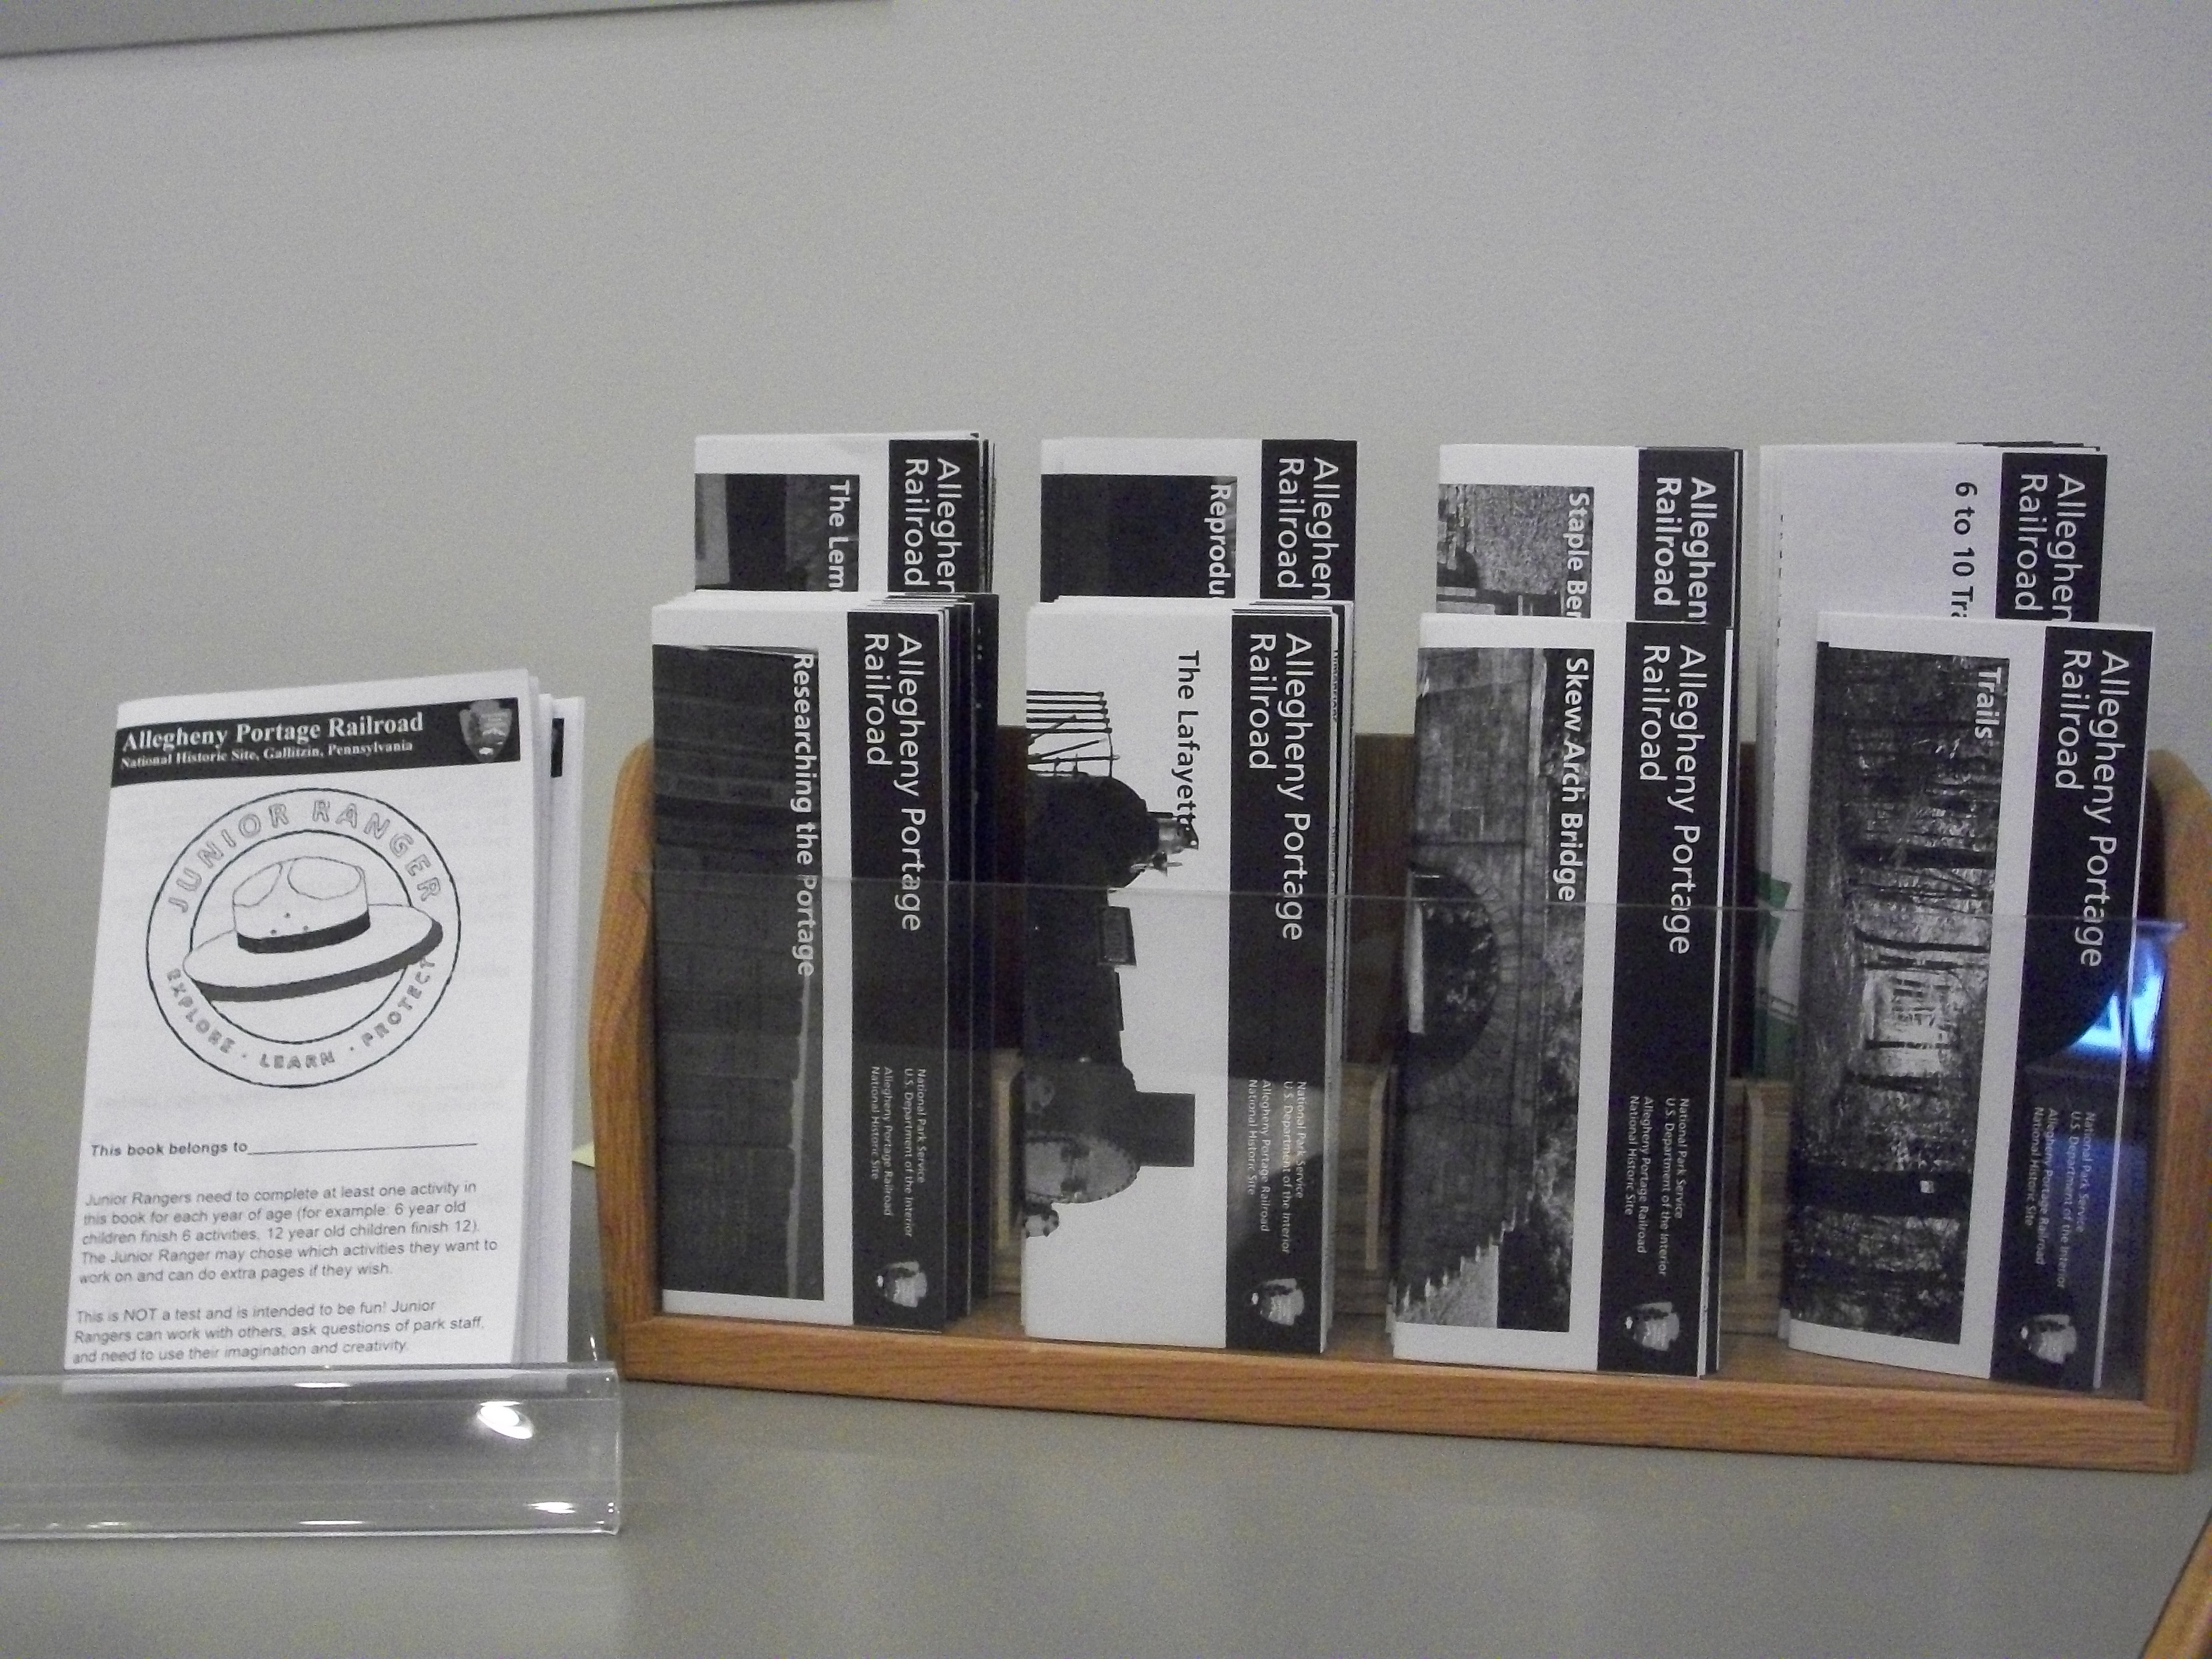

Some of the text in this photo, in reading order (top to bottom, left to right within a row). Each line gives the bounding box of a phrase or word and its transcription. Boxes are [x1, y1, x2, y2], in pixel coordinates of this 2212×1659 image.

[828, 479, 851, 527] The
[904, 459, 930, 585] Railroad
[1203, 484, 1233, 597] Reprodu
[1277, 458, 1305, 588] Railroad
[1564, 492, 1590, 571] Staple
[1654, 478, 1682, 606] Railroad
[1681, 477, 1717, 620] Alleghen
[1953, 482, 1978, 577] 6 to 10
[2015, 474, 2048, 610] Railroad
[123, 712, 423, 751] Allegheny Portage Railroad
[865, 634, 892, 765] Railroad
[1177, 650, 1200, 700] The
[1249, 634, 1276, 769] Railroad
[1640, 645, 1670, 780] Railroad
[1975, 667, 2002, 739] Trails
[2056, 650, 2091, 789] Railroad
[121, 754, 173, 768] National
[176, 751, 227, 764] Historic
[231, 750, 259, 761] Site,
[328, 740, 413, 756] Pennsylvania
[892, 634, 926, 931] Allegheny Portage
[1275, 633, 1313, 940] Allegheny Portage
[1553, 658, 1589, 901] Skew Arch Bridge
[1663, 645, 1707, 954] Allegheny Portage
[2075, 650, 2130, 967] Allegheny Portage
[169, 799, 441, 913] JUNIOR RANGER
[790, 654, 818, 977] Researching the Portage
[166, 957, 436, 1070] EXPLORE LEARN PROTECT
[85, 1182, 477, 1208] Junior Rangers need to complete at least one activity in
[91, 1141, 248, 1157] This book belongs to
[1624, 1095, 1640, 1215] National Historic Site
[1636, 1096, 1653, 1254] Allegheny Portage Railroad
[1661, 1195, 1672, 1208] of
[1662, 1123, 1675, 1192] Department
[1674, 1098, 1690, 1219] National Park Service
[82, 1232, 136, 1245] children
[140, 1230, 178, 1243] finish
[182, 1229, 191, 1242] 6
[268, 1227, 284, 1240] 12
[288, 1228, 320, 1242] year
[324, 1225, 345, 1238] old
[349, 1223, 406, 1237] children
[410, 1221, 449, 1234] finish
[82, 1239, 498, 1265] The Junior Ranger may chose which activities they want to
[84, 1214, 107, 1225] this
[111, 1212, 145, 1225] book
[150, 1211, 169, 1224] for
[173, 1211, 208, 1223] each
[212, 1211, 243, 1224] year
[248, 1207, 262, 1221] of
[265, 1209, 293, 1224] age
[394, 1202, 404, 1215] 6
[409, 1204, 441, 1218] year
[444, 1200, 466, 1213] old
[1658, 1233, 1670, 1276] Interior
[1660, 1211, 1671, 1230] the
[77, 1301, 436, 1323] This is NOT a test and is intended to be fun! Junior
[79, 1271, 110, 1285] work
[114, 1272, 133, 1283] on
[137, 1270, 164, 1283] and
[168, 1271, 194, 1282] can
[198, 1268, 216, 1281] do
[220, 1268, 257, 1280] extra
[260, 1267, 305, 1282] pages
[309, 1264, 319, 1277] if
[322, 1265, 352, 1279] they
[72, 1350, 97, 1364] and
[101, 1349, 137, 1363] need
[140, 1349, 154, 1361] to
[158, 1349, 185, 1361] use
[189, 1347, 220, 1360] their
[225, 1345, 306, 1360] imagination
[310, 1342, 338, 1354] and
[74, 1330, 132, 1346] Rangers
[136, 1331, 163, 1342] can
[166, 1328, 200, 1340] work
[205, 1326, 233, 1339] with
[291, 1324, 316, 1337] ask
[321, 1322, 390, 1337] questions
[395, 1318, 410, 1332] of
[413, 1318, 445, 1333] park
